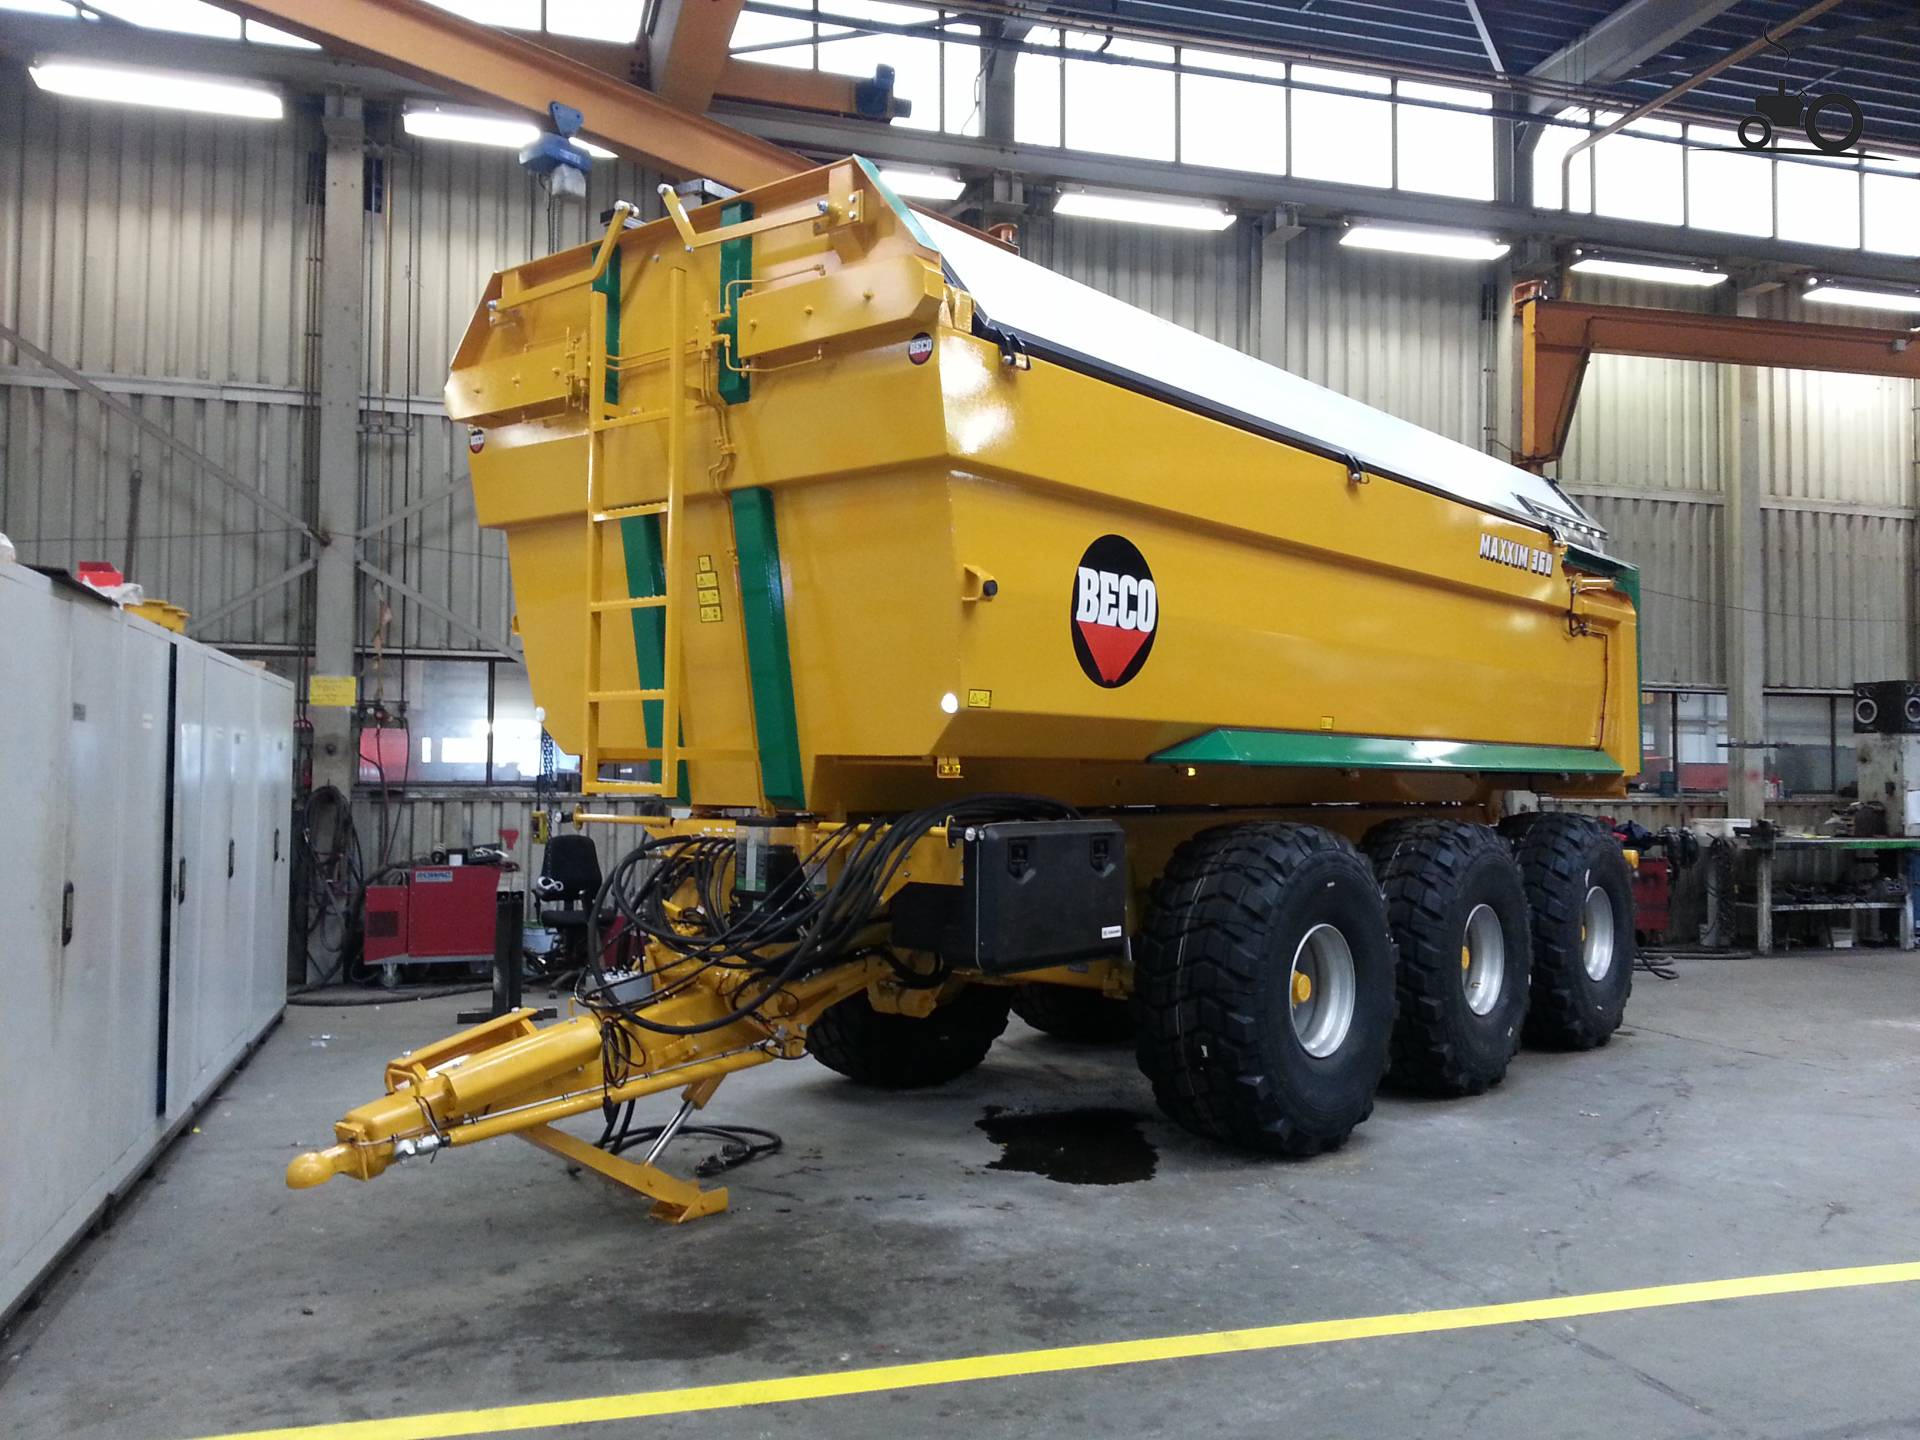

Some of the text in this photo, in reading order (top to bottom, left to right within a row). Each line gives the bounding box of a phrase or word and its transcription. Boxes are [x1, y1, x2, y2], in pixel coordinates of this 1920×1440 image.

[909, 338, 932, 354] BECO
[1480, 532, 1530, 571] MAXXIM
[1076, 566, 1156, 633] BECO
